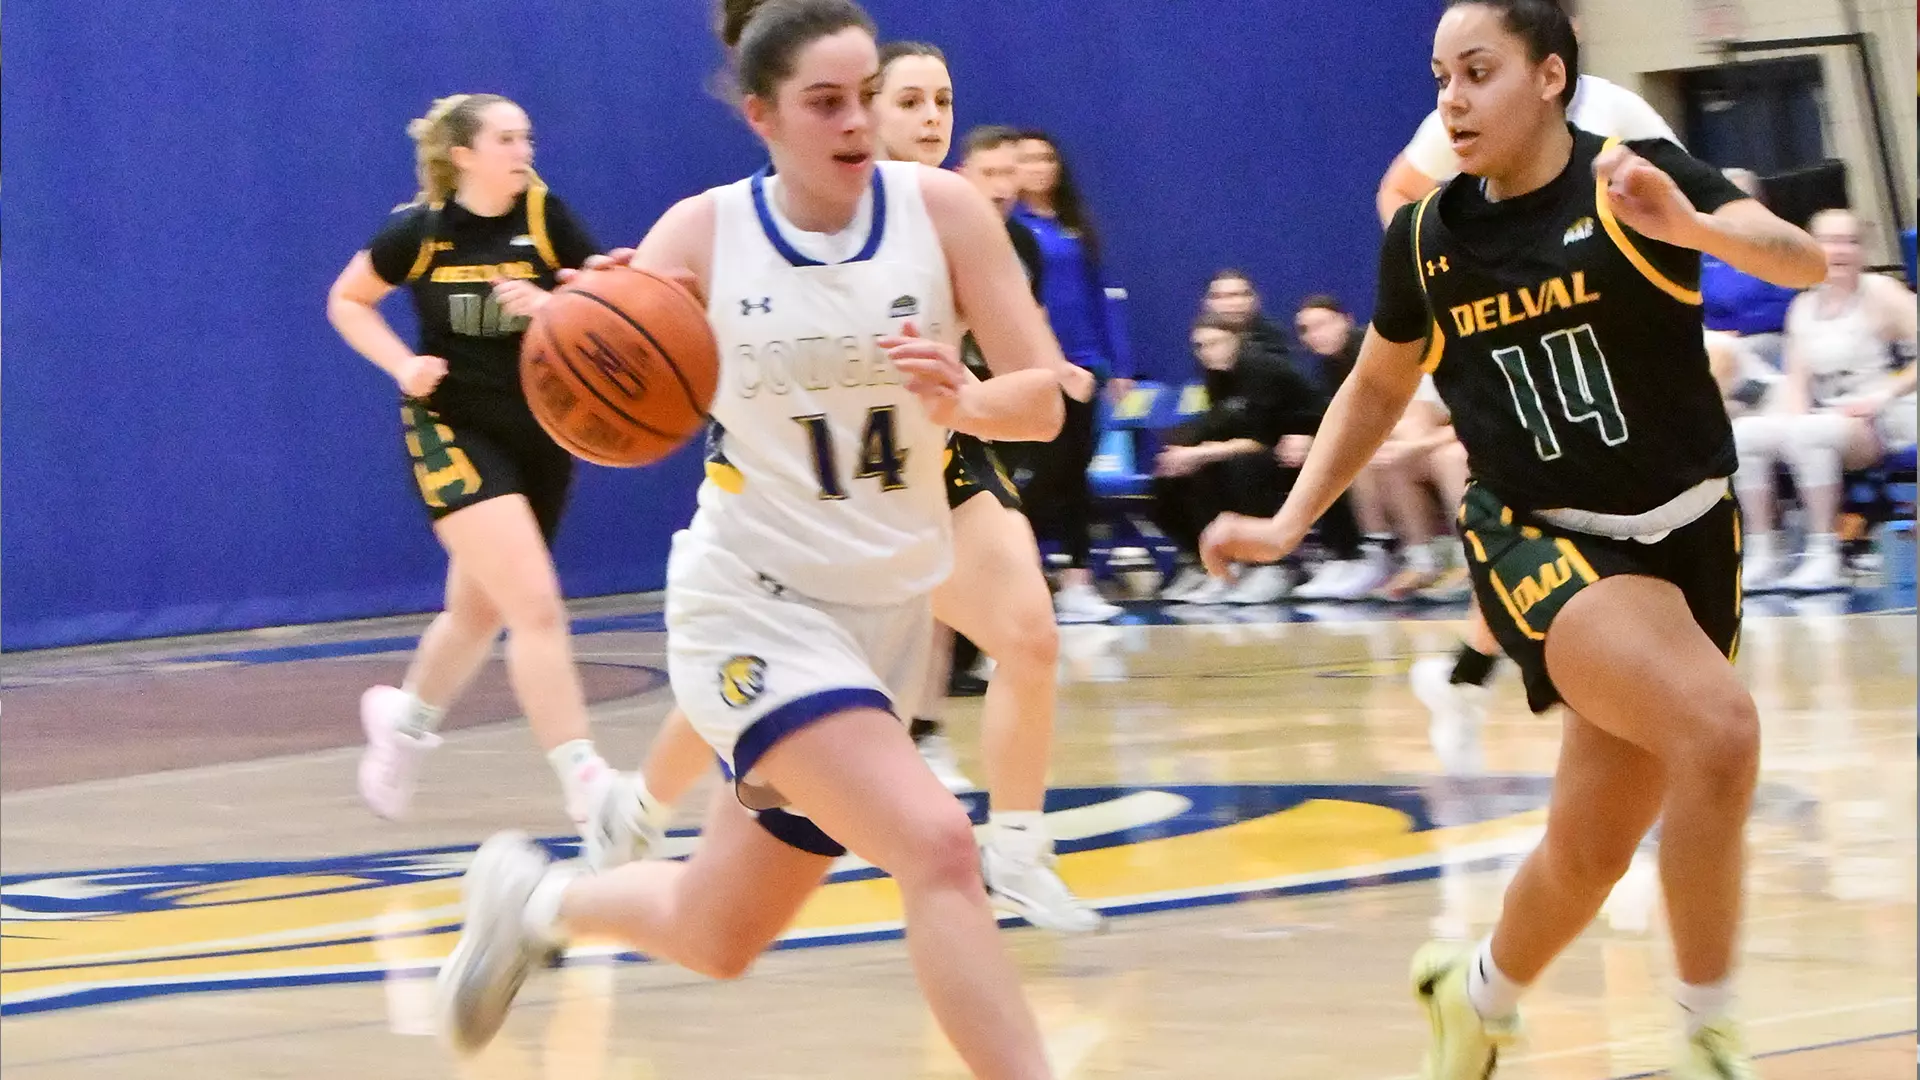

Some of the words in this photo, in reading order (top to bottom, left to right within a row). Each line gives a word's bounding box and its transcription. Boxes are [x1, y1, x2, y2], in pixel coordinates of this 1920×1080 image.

[1449, 271, 1601, 338] DELVAL
[1492, 323, 1629, 461] 14
[790, 404, 909, 500] 14
